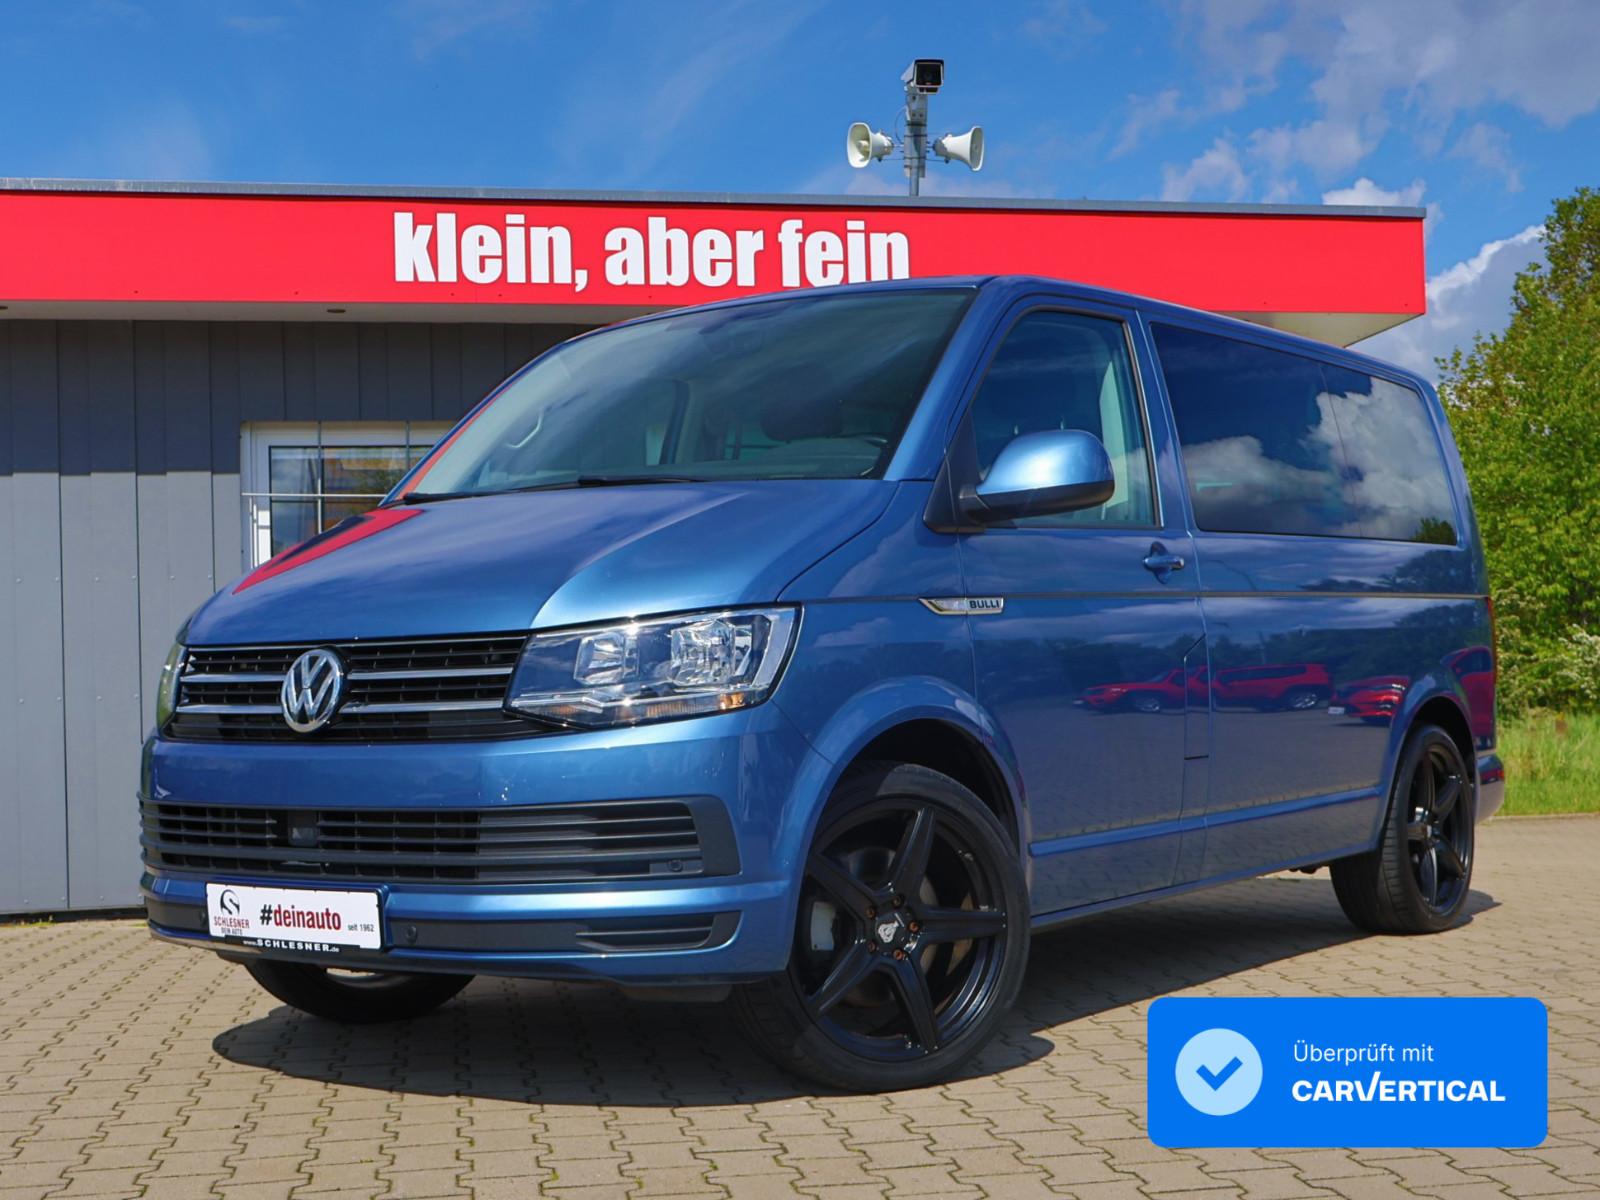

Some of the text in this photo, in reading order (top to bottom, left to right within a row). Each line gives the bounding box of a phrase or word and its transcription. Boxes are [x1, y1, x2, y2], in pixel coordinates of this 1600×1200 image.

[393, 212, 911, 293] klein, aber fein
[969, 600, 999, 608] BULLI
[213, 916, 250, 929] SCHLESNER
[260, 904, 341, 930] #deinauto
[360, 924, 374, 932] 1962
[243, 938, 339, 952] www.SCHLESNER.de
